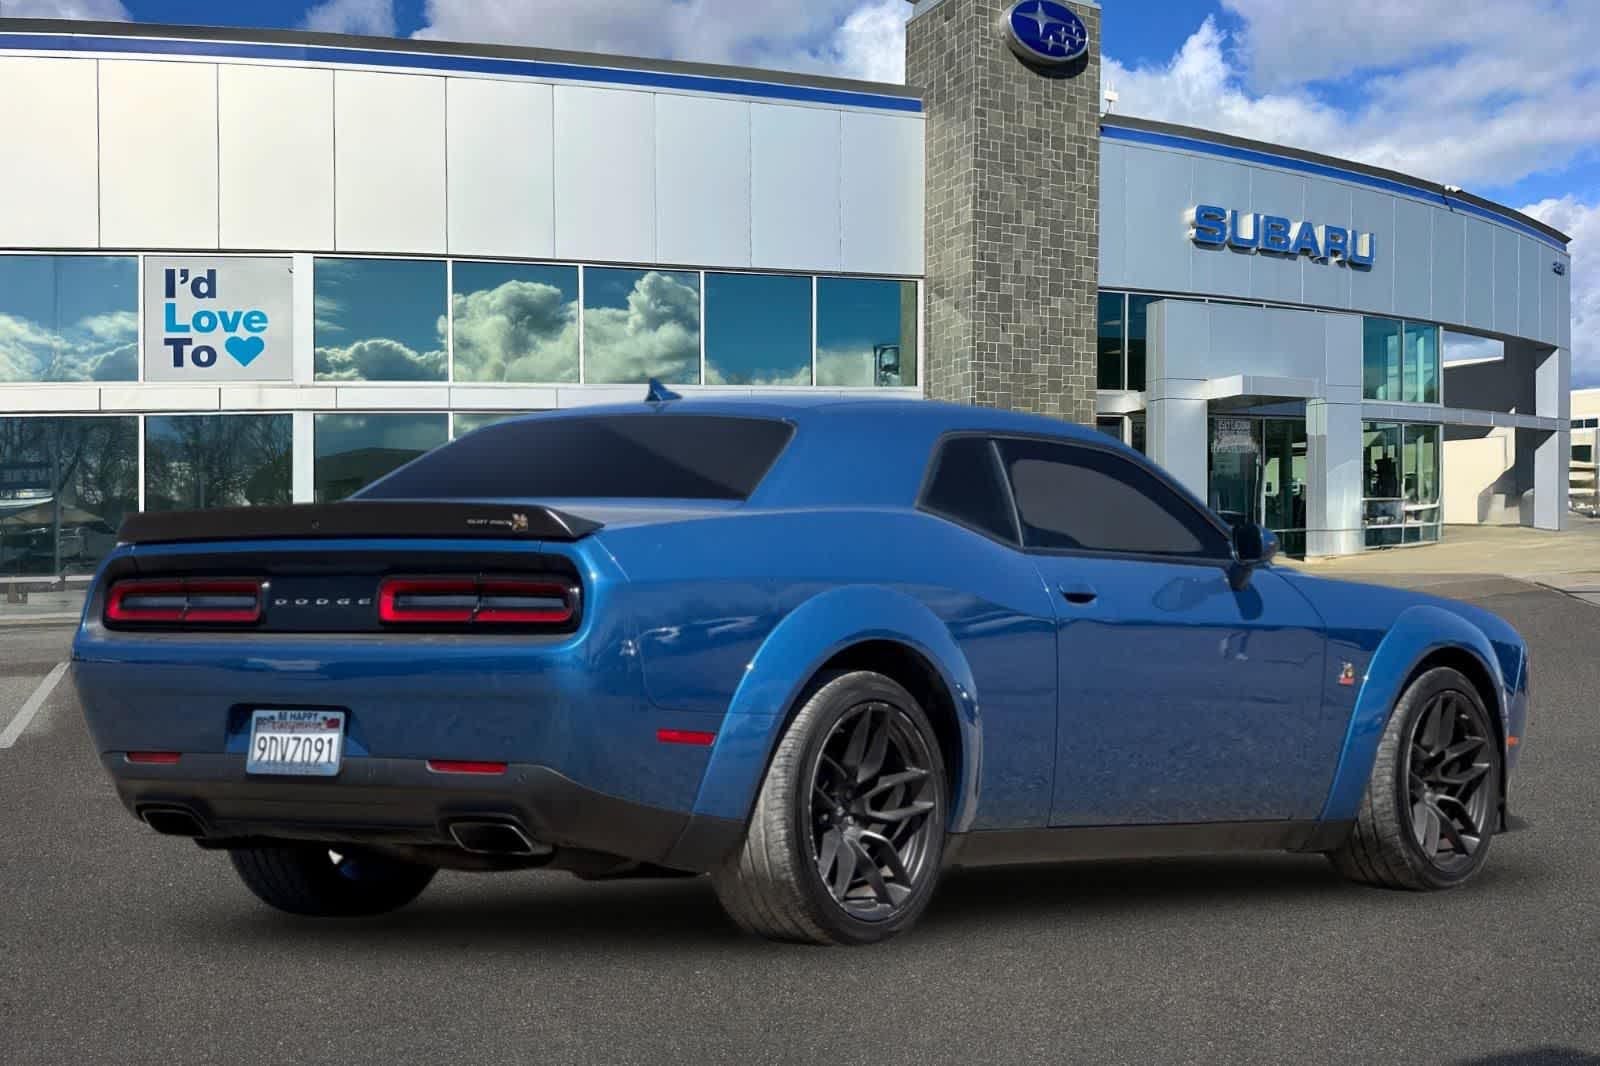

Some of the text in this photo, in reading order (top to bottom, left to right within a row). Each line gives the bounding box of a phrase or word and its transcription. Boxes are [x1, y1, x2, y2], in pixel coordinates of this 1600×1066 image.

[1191, 204, 1376, 269] SUBARU
[165, 302, 268, 333] Love
[164, 337, 217, 368] To
[275, 597, 371, 606] DODGE
[290, 711, 319, 721] HAPPY
